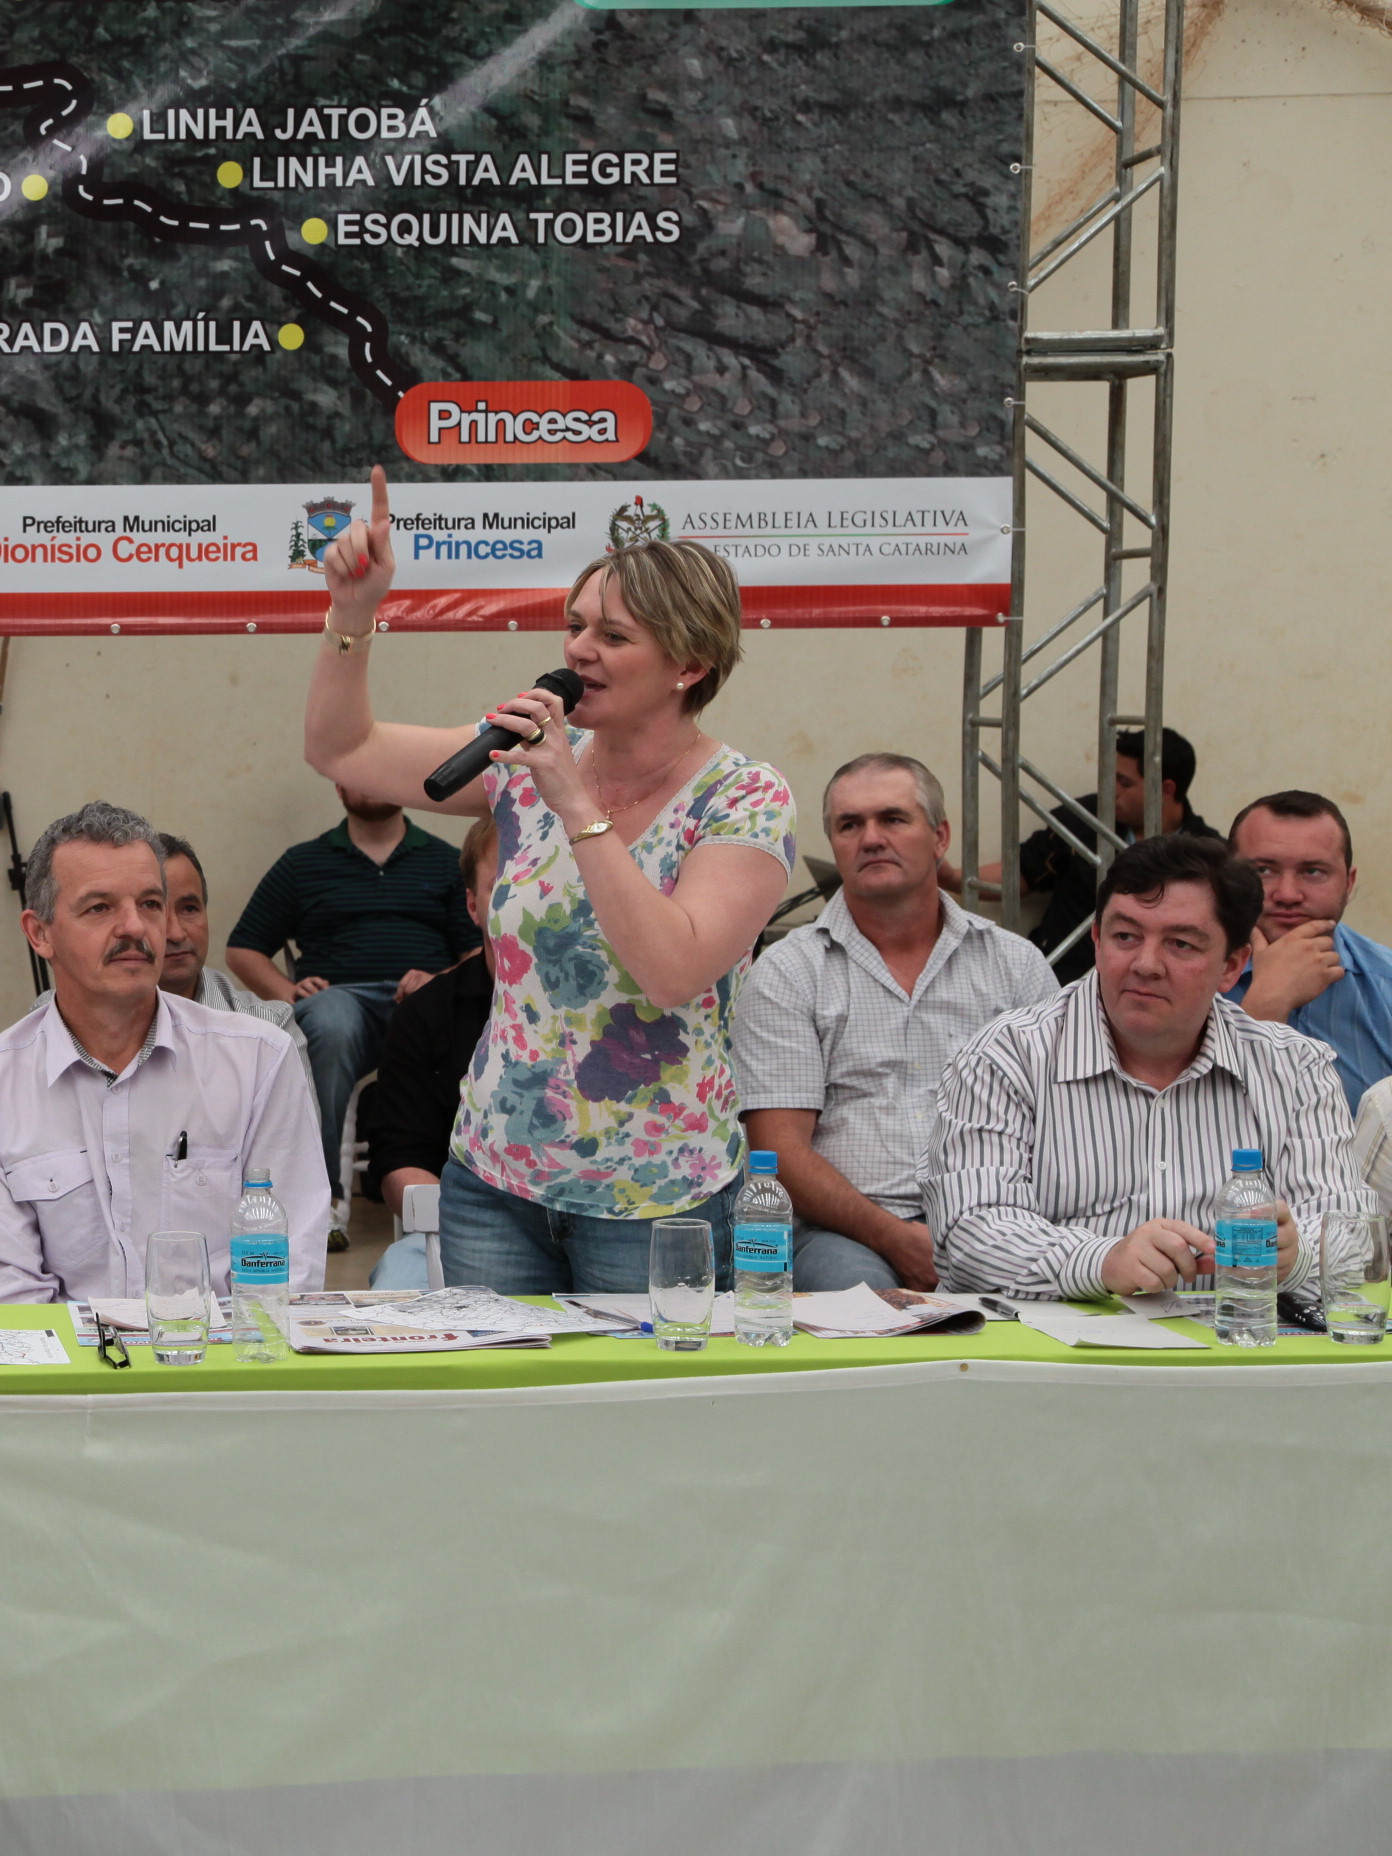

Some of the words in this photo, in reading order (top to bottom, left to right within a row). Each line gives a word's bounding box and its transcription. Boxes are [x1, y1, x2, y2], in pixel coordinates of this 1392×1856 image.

[141, 107, 264, 140] LINHA
[275, 98, 437, 140] JATOBÁ
[251, 156, 374, 188] LINHA
[385, 154, 499, 187] VISTA
[509, 152, 678, 185] ALEGRE
[336, 212, 518, 247] ESQUINA
[530, 210, 680, 244] TOBIAS
[111, 312, 271, 353] FAMÍLIA
[428, 402, 618, 444] Princesa
[22, 515, 116, 534] Prefeitura
[122, 514, 216, 537] Municipal
[388, 513, 475, 531] Prefeitura
[482, 512, 576, 534] Municipal
[681, 511, 818, 530] ASSEMBLEIA
[827, 510, 969, 528] LEGISLATIVA
[112, 535, 259, 569] Cerqueira
[413, 533, 543, 560] Princesa
[714, 543, 782, 558] ESTADO
[789, 543, 811, 557] DE
[817, 543, 874, 557] SANTA
[879, 542, 969, 556] CATARINA
[241, 1257, 286, 1268] Danferrana
[322, 1333, 459, 1344] fronteira
